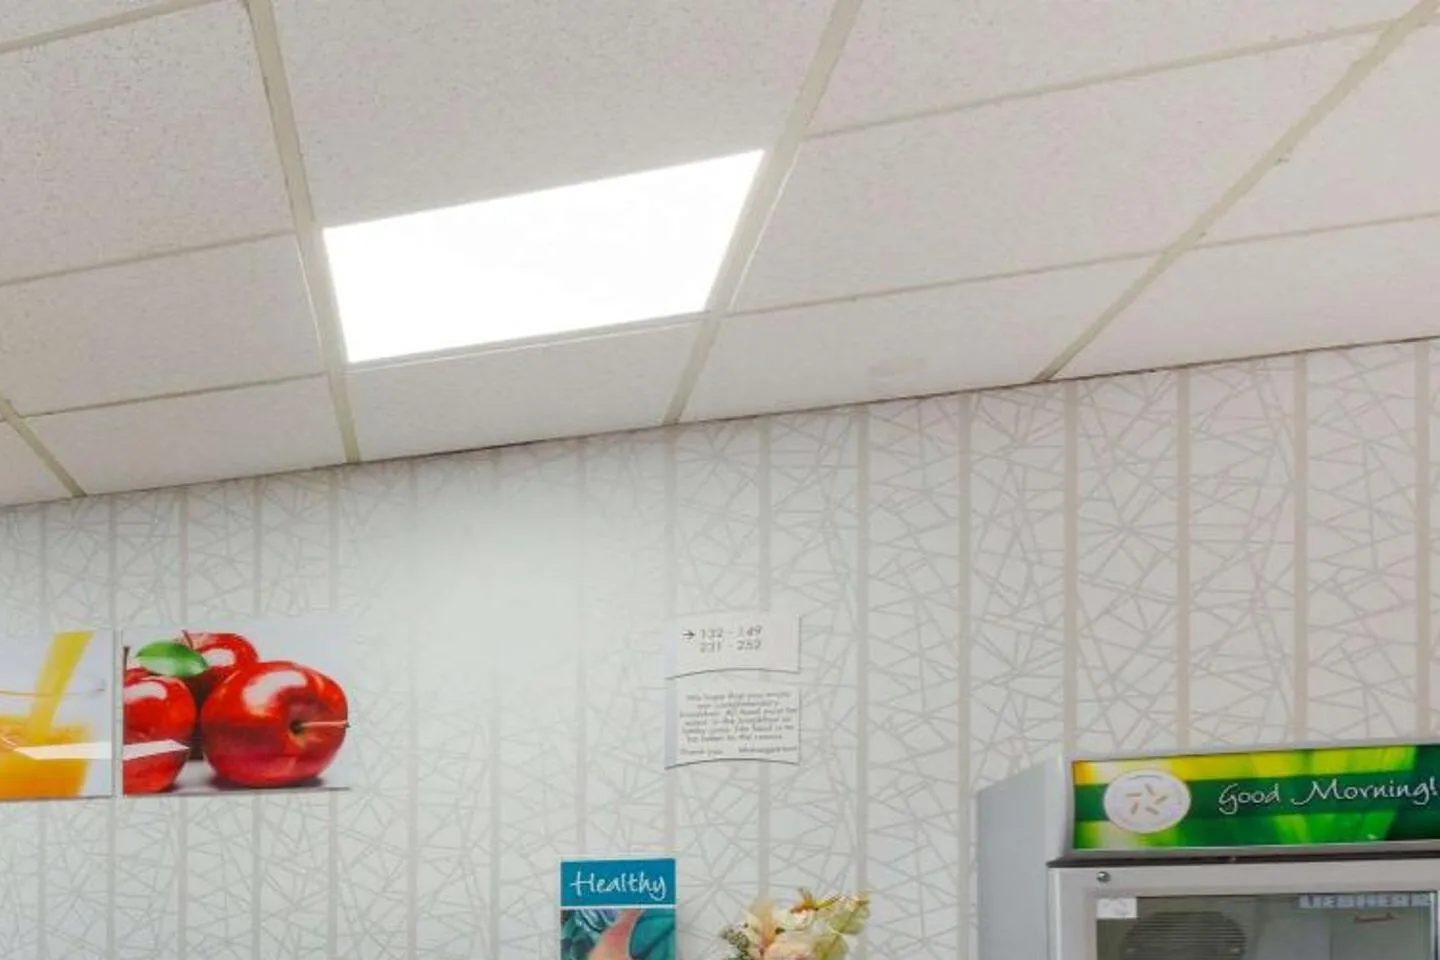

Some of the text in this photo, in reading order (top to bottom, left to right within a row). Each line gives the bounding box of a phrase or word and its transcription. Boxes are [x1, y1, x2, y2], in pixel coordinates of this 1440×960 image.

[1218, 776, 1439, 815] Good Morning!
[570, 870, 666, 901] Healthy
